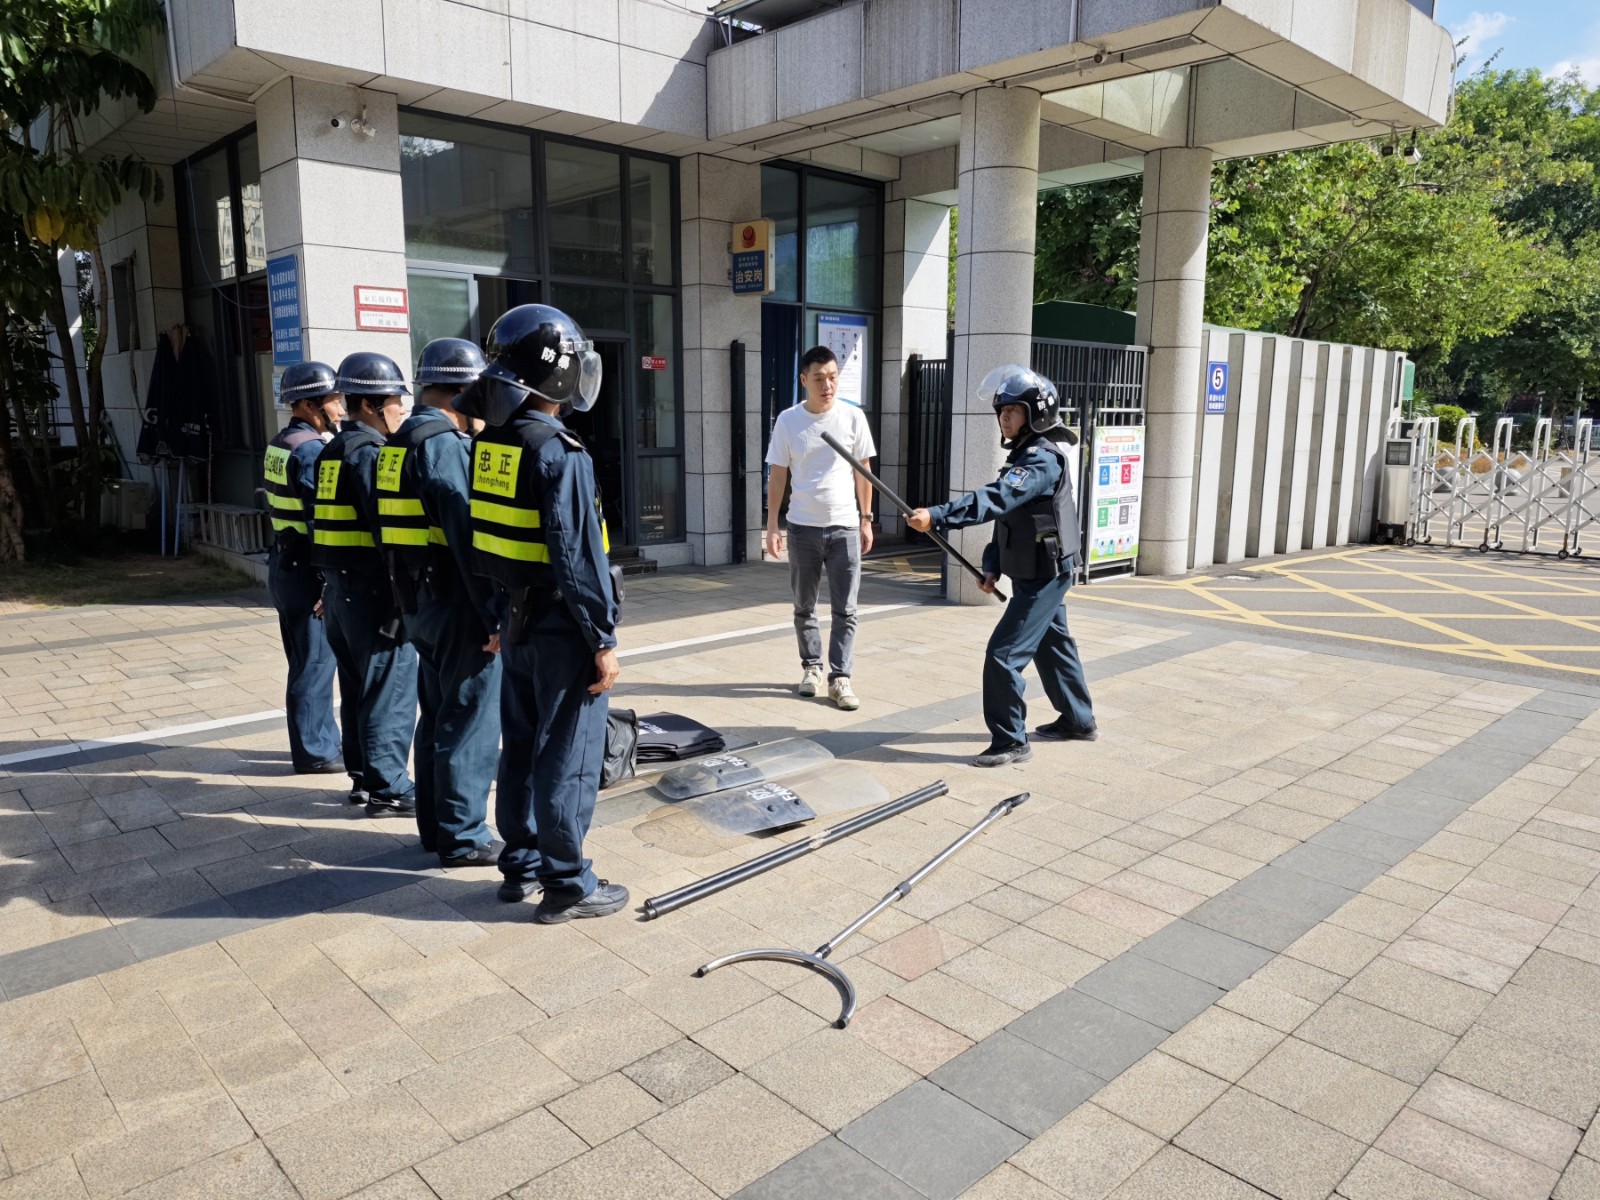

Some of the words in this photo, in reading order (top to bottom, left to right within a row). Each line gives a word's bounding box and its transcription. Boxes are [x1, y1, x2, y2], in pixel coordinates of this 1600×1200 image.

[735, 268, 763, 284] 治安岗
[1214, 369, 1222, 388] 5
[378, 452, 400, 473] 忠正
[478, 448, 513, 477] 忠正
